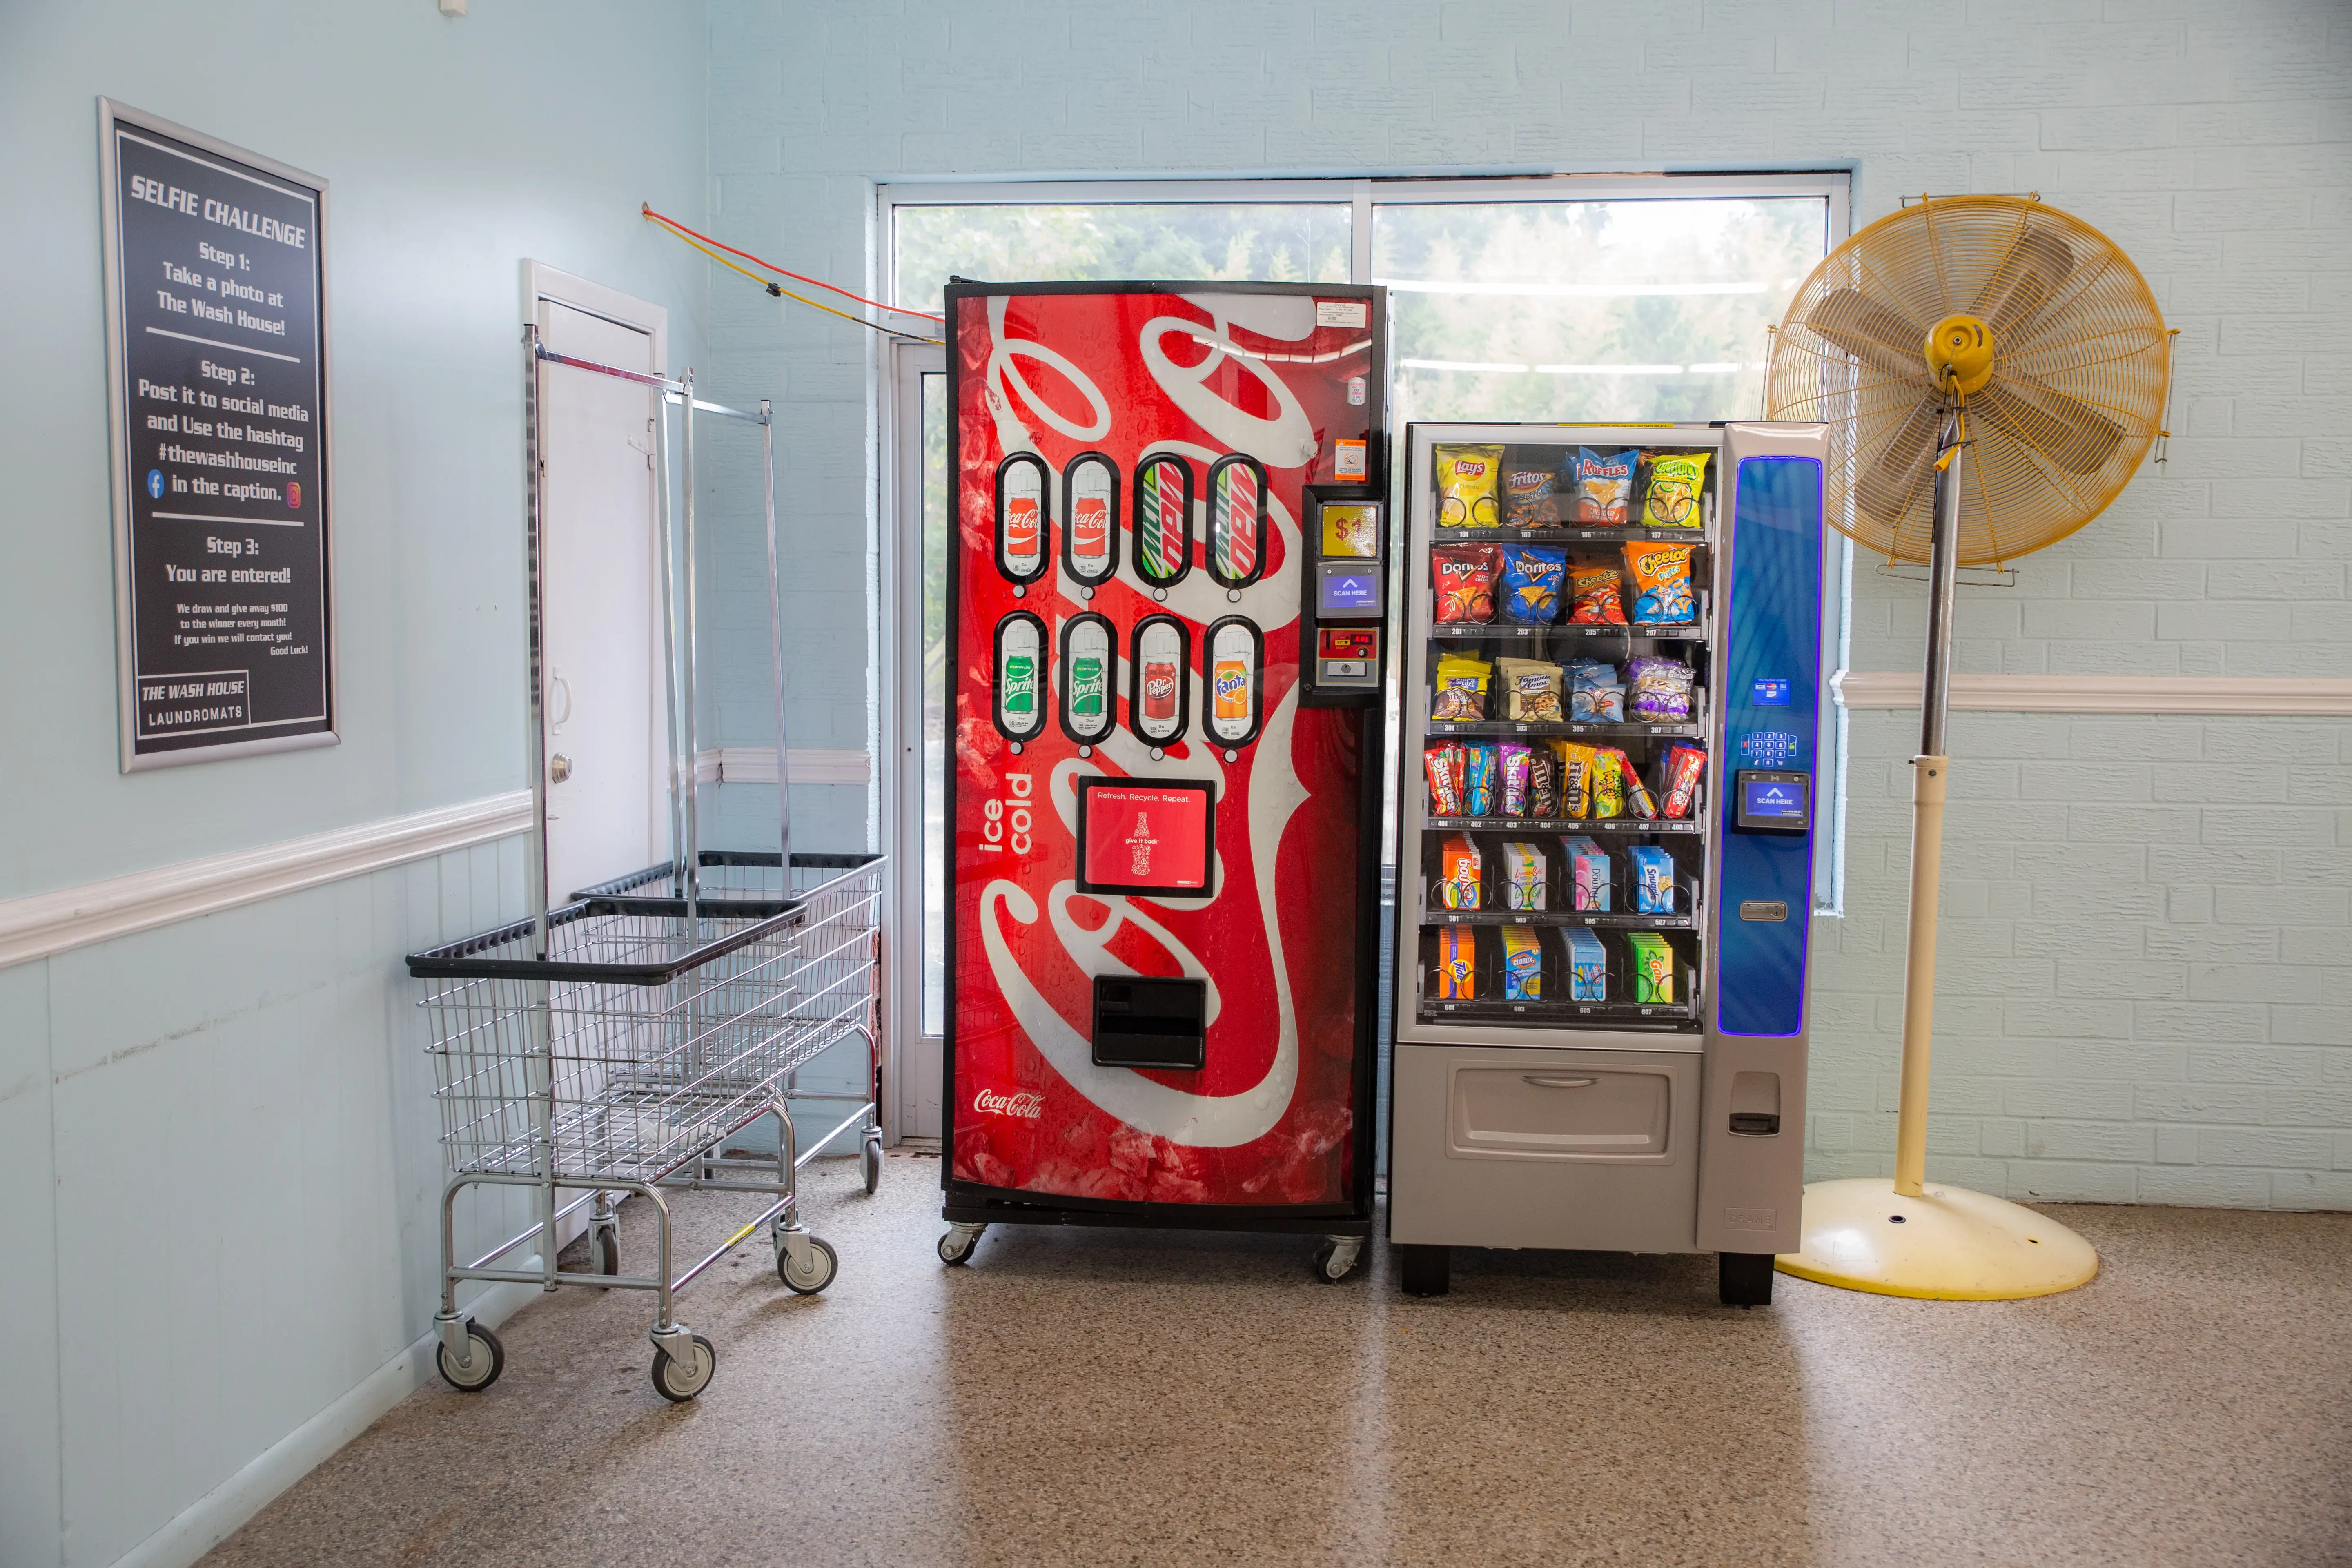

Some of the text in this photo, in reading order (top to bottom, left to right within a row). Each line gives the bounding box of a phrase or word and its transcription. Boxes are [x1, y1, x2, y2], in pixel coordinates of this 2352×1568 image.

[132, 175, 305, 249] SELFIE CHALLENGE
[200, 242, 250, 271] Step 1:
[163, 262, 283, 307] Take a photo at
[157, 290, 285, 336] The Wash House!
[201, 360, 255, 385] Step 2:
[139, 379, 308, 422] Post it to social media
[147, 415, 303, 452] and Use the hashtag
[159, 443, 297, 474] #thewashhouseinc
[1456, 460, 1485, 476] Lay's
[1583, 459, 1628, 477] RUFFLES
[172, 475, 281, 501] in the caption.
[1509, 472, 1545, 488] Fritos
[1008, 509, 1038, 528] oca-Col
[1075, 509, 1106, 529] oca-Col
[207, 537, 259, 558] Step 3:
[1516, 561, 1562, 573] Doritos
[1638, 548, 1689, 576] Cheetos
[166, 564, 291, 583] You are entered!
[1577, 570, 1618, 587] Cheetos
[177, 603, 287, 615] We draw and give away $100
[180, 618, 286, 629] to the winner every month!
[174, 635, 181, 644] If
[184, 636, 199, 646] you
[202, 635, 216, 644] win
[231, 634, 244, 642] will
[247, 633, 274, 641] contact
[276, 632, 292, 642] you!
[270, 646, 308, 655] Good Luck!
[1149, 680, 1172, 696] Pepper
[1156, 678, 1167, 687] Dr
[1515, 675, 1550, 685] Famous
[1519, 681, 1548, 690] Amos
[143, 681, 245, 701] THE WASH HOUSE
[149, 706, 242, 726] LAUNDROMATS
[1434, 757, 1455, 811] Skittles
[1504, 755, 1520, 813] Skittles
[1604, 771, 1616, 800] PATCH
[1613, 770, 1623, 798] SOUR
[1098, 792, 1127, 800] Refresh.
[1129, 793, 1160, 802] Recycle.
[1005, 773, 1032, 855] cold
[979, 799, 1003, 852] ice
[1456, 858, 1475, 901] bounce
[1515, 866, 1542, 878] LaundroSak
[1589, 868, 1600, 898] Downy
[1646, 868, 1659, 900] Snuggle
[1453, 961, 1468, 982] Tide
[1650, 959, 1664, 986] Gain
[974, 1089, 1046, 1118] Coca-Cola
[1729, 1214, 1771, 1224] CRANE
